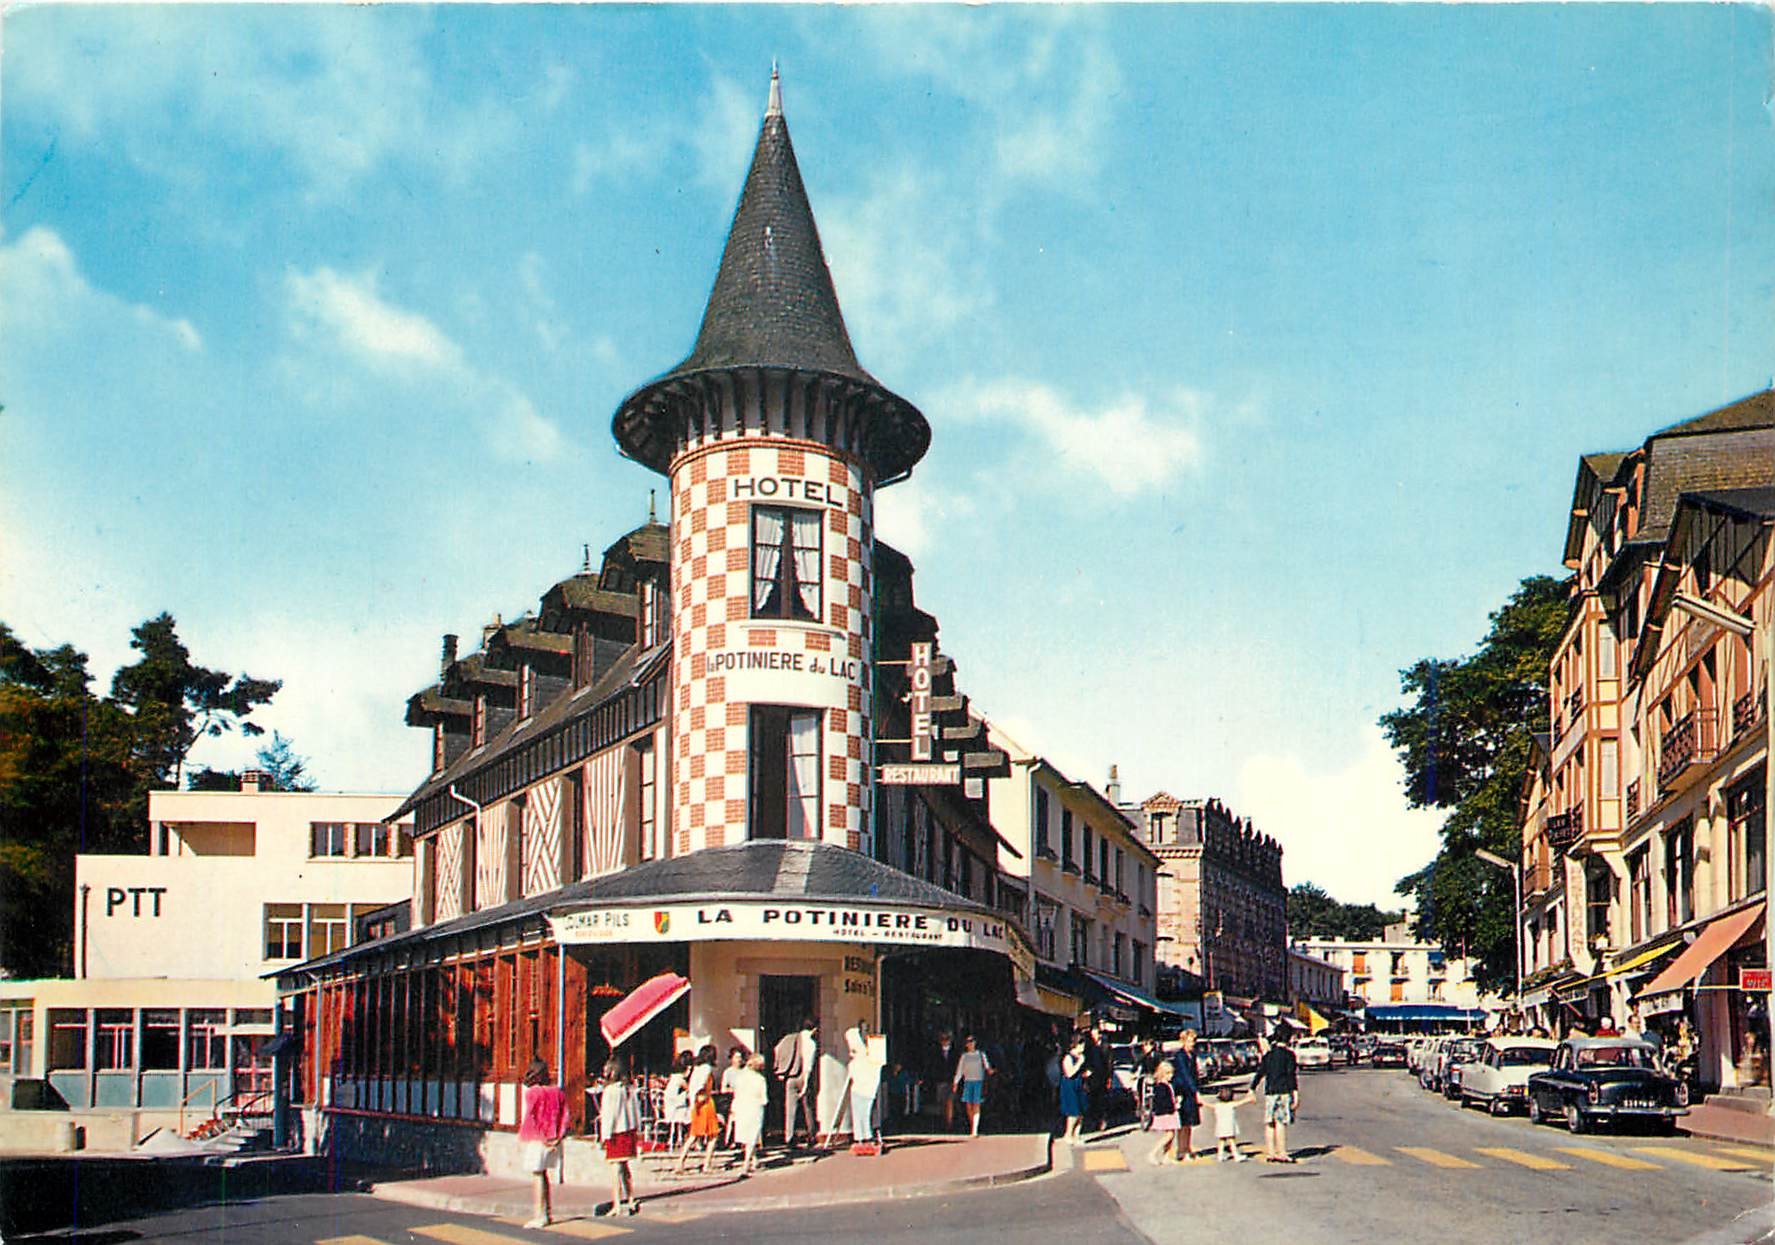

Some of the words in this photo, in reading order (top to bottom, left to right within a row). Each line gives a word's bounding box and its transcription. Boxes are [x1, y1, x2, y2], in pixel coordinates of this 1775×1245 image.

[734, 477, 844, 507] HOTEL
[715, 652, 804, 672] POTINIERE
[809, 658, 826, 674] du
[830, 658, 856, 681] LAC
[914, 643, 930, 761] HOTEL
[883, 765, 960, 784] RESTAURANT
[106, 887, 168, 918] PTT
[604, 911, 630, 927] PILS
[697, 908, 734, 924] LA
[763, 909, 928, 931] POTINIERE
[946, 916, 973, 934] DU
[983, 922, 1004, 940] LAC
[833, 928, 865, 937] HOTEL
[884, 930, 943, 941] RESTAURANT
